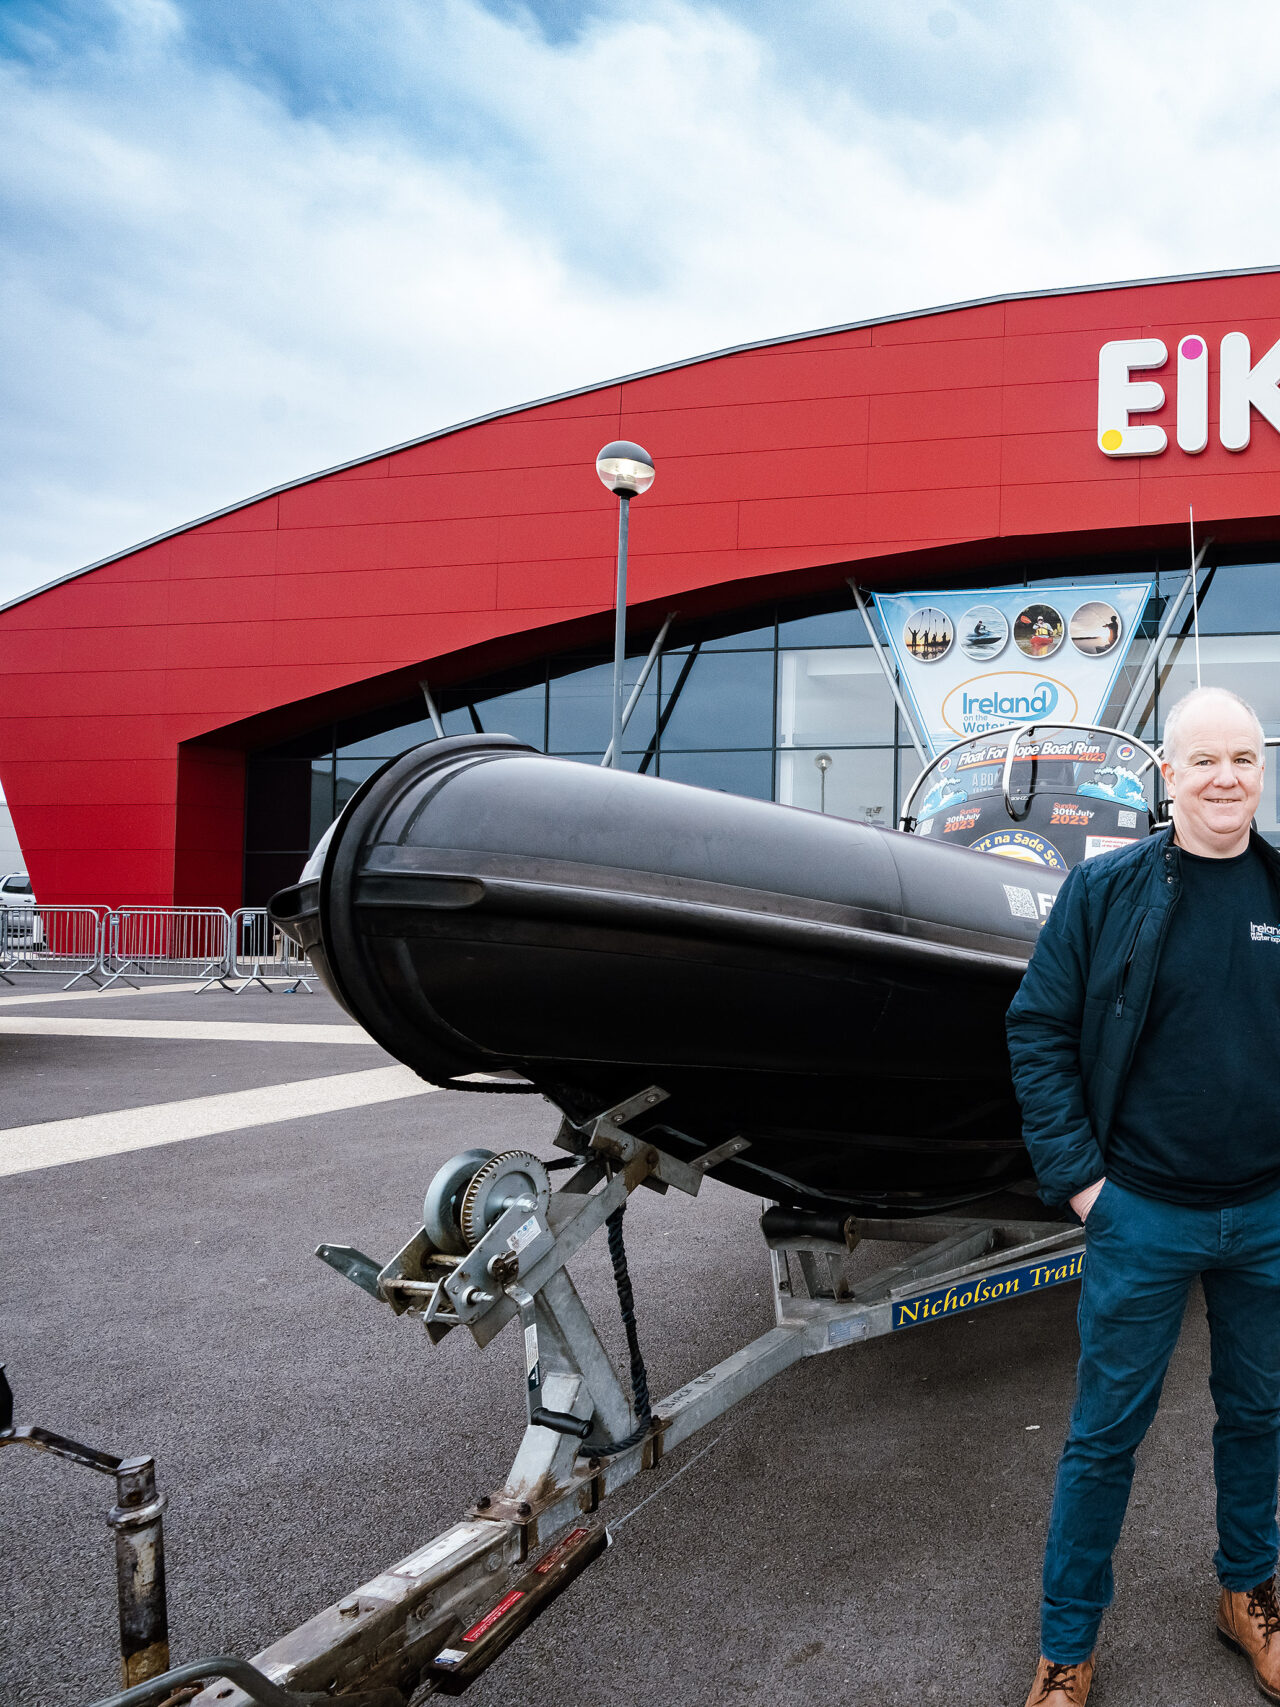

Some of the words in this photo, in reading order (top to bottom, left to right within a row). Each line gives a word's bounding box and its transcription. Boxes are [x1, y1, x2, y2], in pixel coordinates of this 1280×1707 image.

[962, 690, 1047, 715] Ireland
[958, 750, 987, 766] Float
[986, 746, 1007, 760] For
[1041, 741, 1073, 755] Boat
[1073, 741, 1101, 754] Run
[1079, 752, 1106, 762] 2023
[960, 807, 981, 815] Sunday
[1053, 802, 1080, 810] Sunday
[943, 818, 976, 833] 2023
[1050, 814, 1089, 826] 2023
[974, 838, 992, 852] ort
[994, 834, 1011, 845] na
[1013, 832, 1045, 853] Sade
[1043, 849, 1061, 868] Se
[897, 1276, 1020, 1326] Nicholson
[1029, 1252, 1087, 1288] Trail
